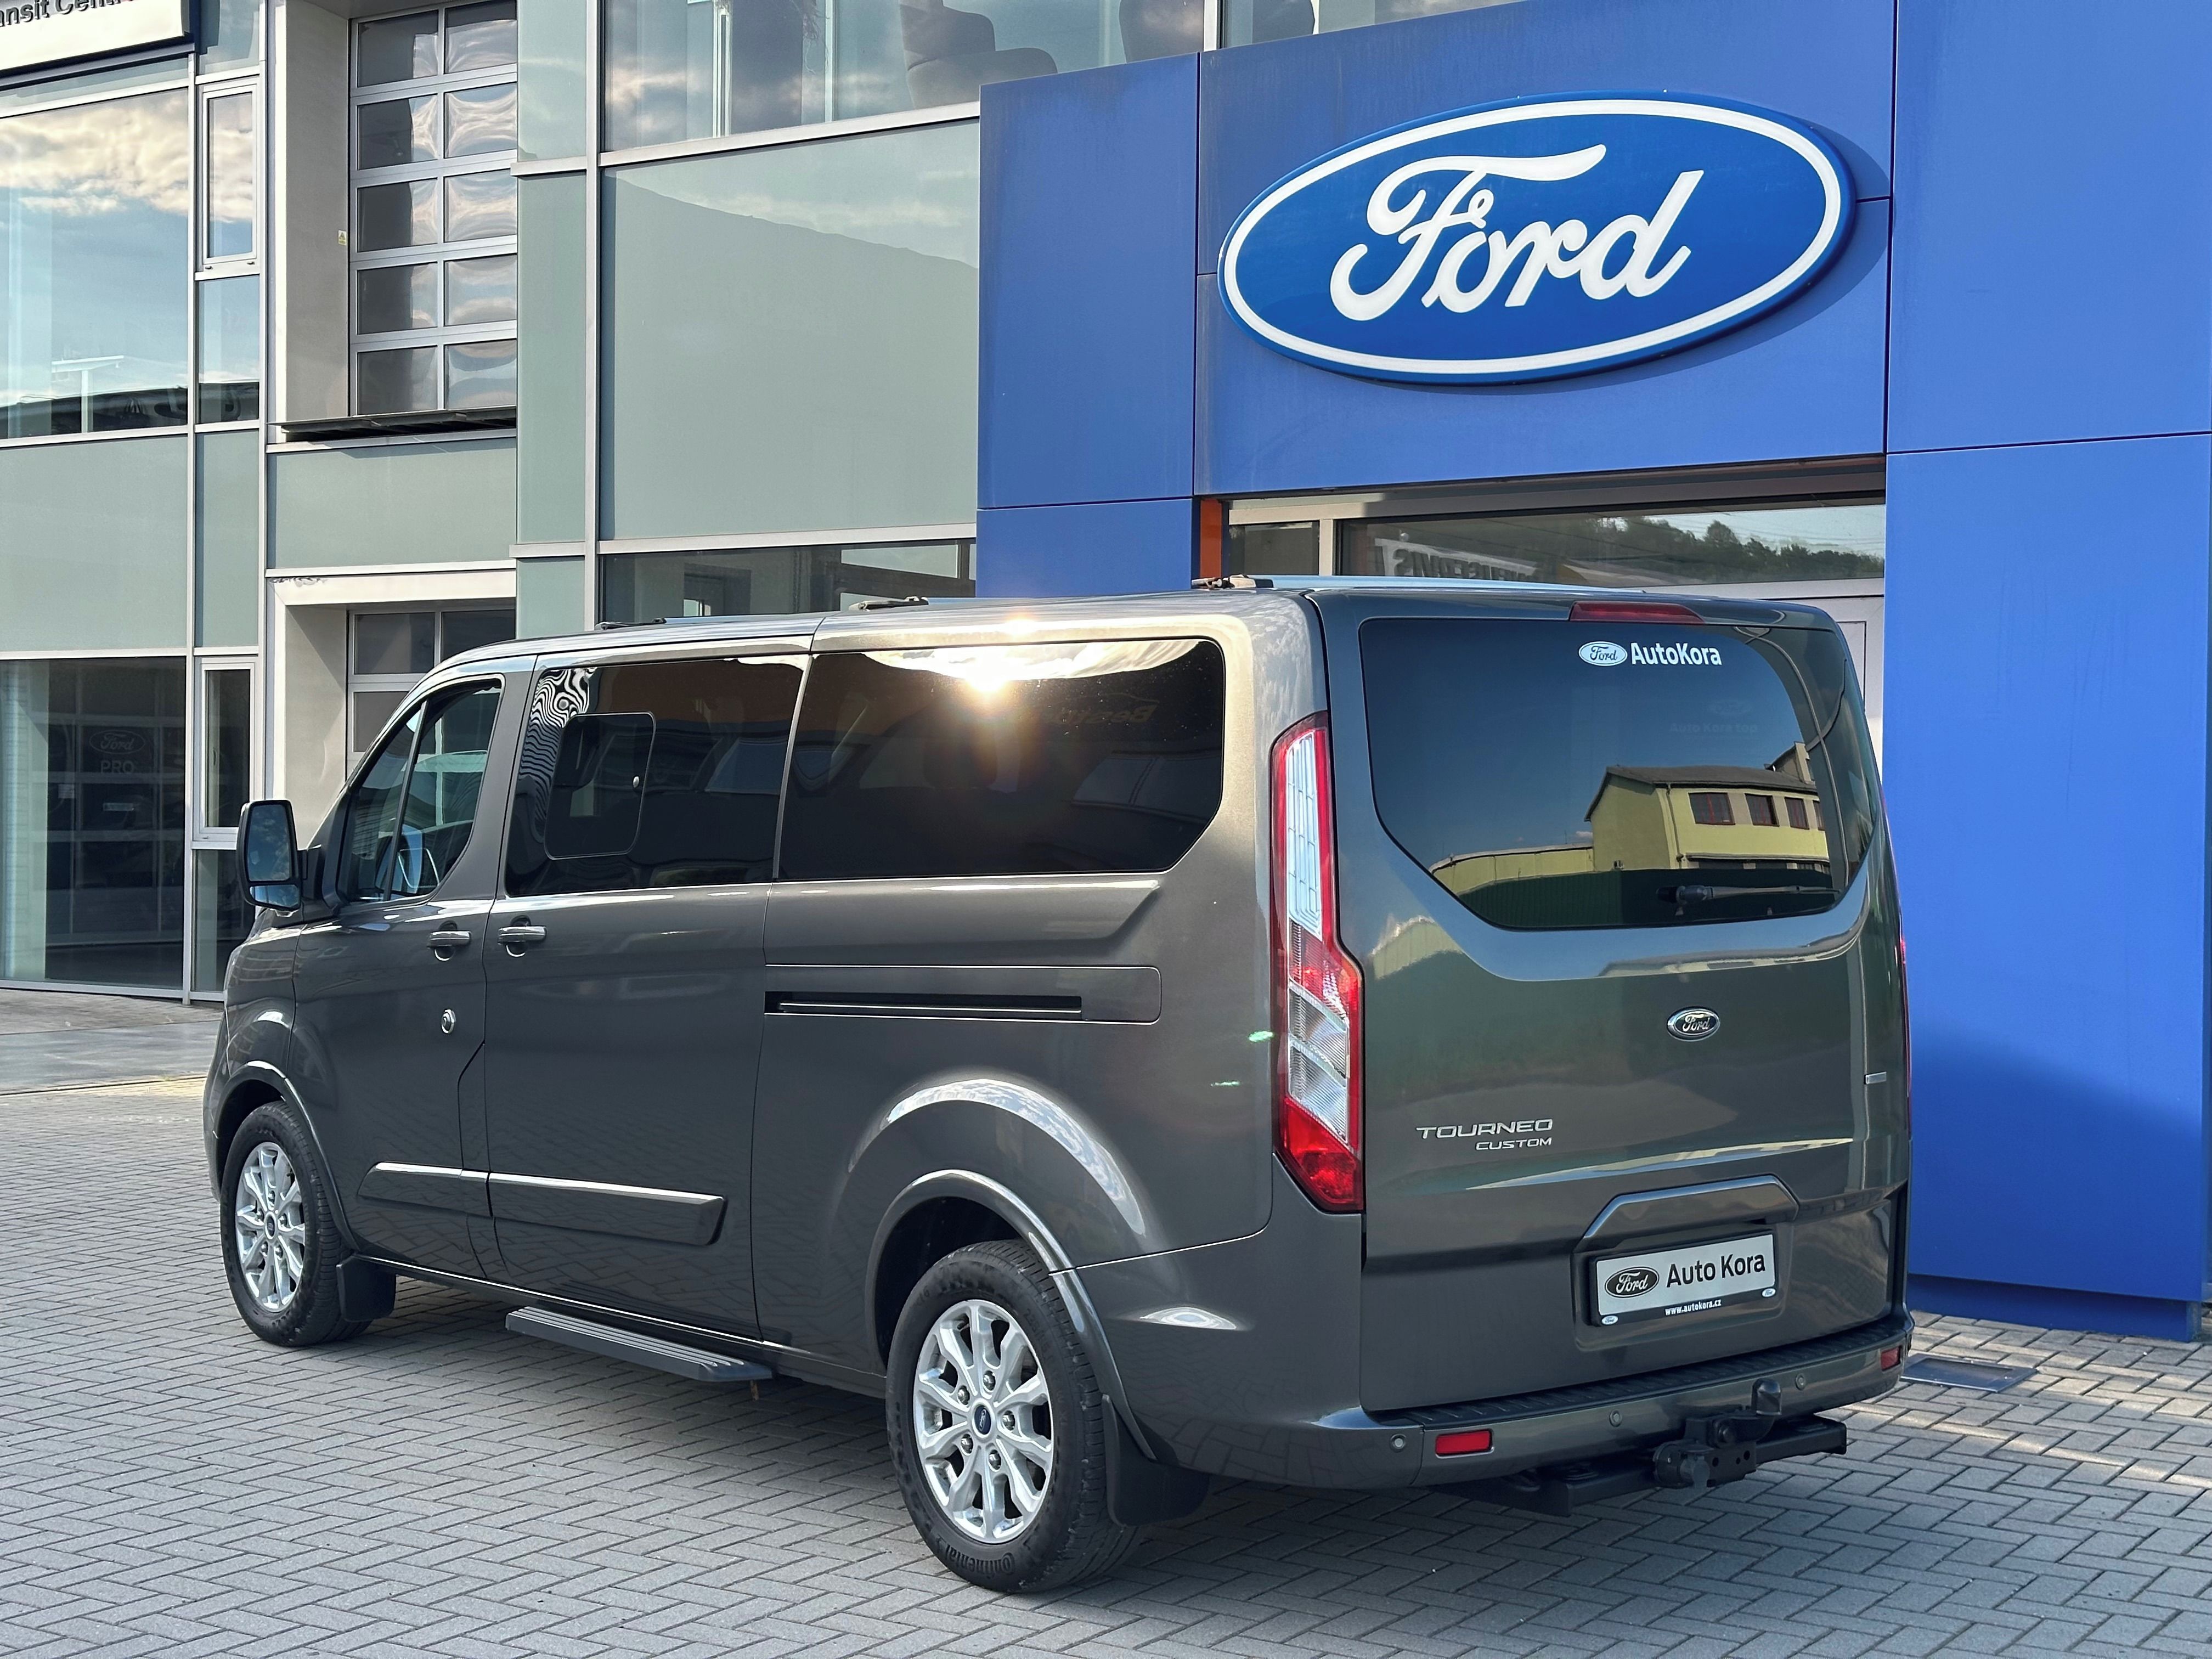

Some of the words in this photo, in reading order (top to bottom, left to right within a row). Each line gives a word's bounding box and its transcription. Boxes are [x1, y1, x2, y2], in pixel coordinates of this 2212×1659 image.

[1330, 144, 1704, 321] Ford
[1590, 646, 1617, 661] Ford
[1630, 642, 1722, 665] AutoKora
[100, 732, 135, 751] Ford
[101, 760, 134, 774] PRO
[1682, 1014, 1710, 1032] Ford
[1416, 1119, 1553, 1139] TOURNEO
[1475, 1137, 1552, 1150] CUSTOM
[1616, 1272, 1649, 1294] Ford
[1666, 1260, 1716, 1288] Auto
[1720, 1254, 1766, 1279] Kora
[1664, 1299, 1722, 1316] www.autokora.cz
[944, 1544, 1015, 1579] Continental
